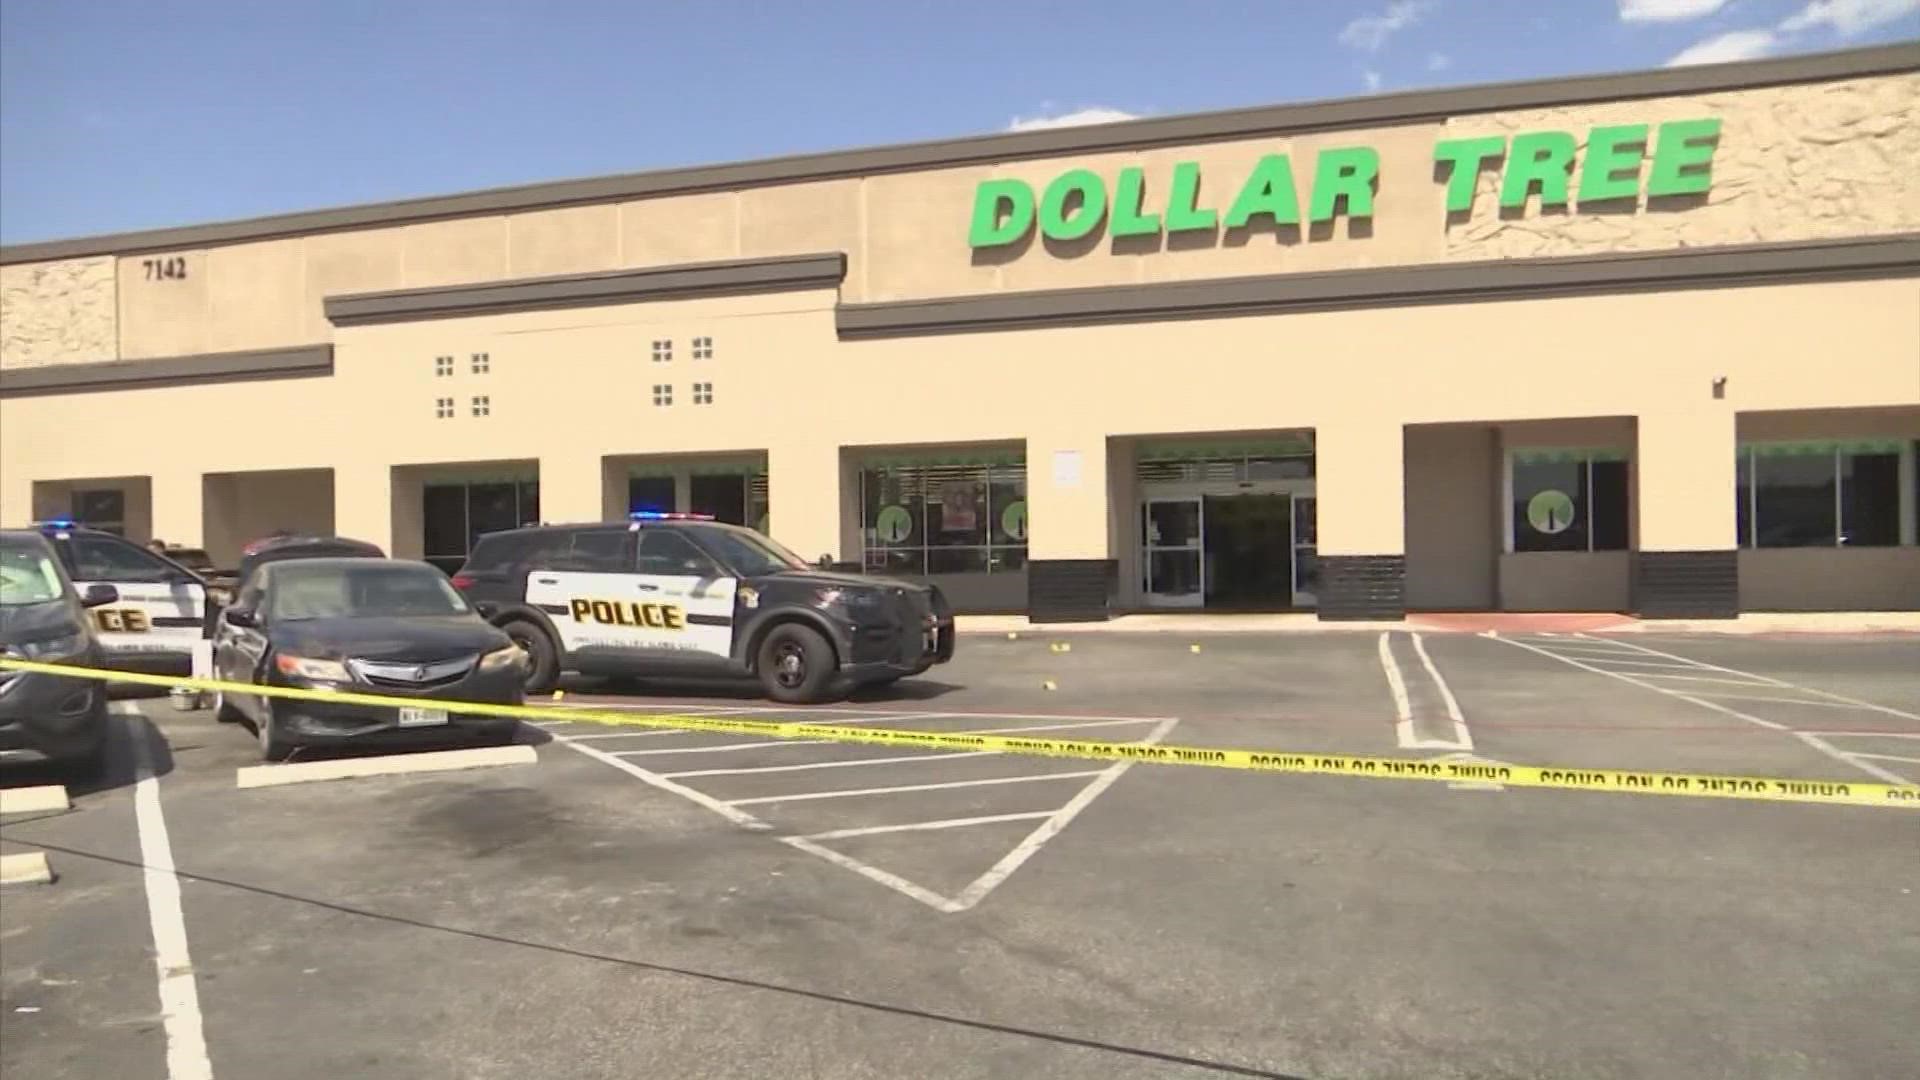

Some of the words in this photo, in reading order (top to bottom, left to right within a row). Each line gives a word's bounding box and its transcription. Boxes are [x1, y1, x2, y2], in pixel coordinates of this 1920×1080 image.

[969, 146, 1380, 248] DOLLAR
[1434, 118, 1723, 211] TREE
[143, 256, 186, 280] 7142
[570, 598, 683, 630] POLICE
